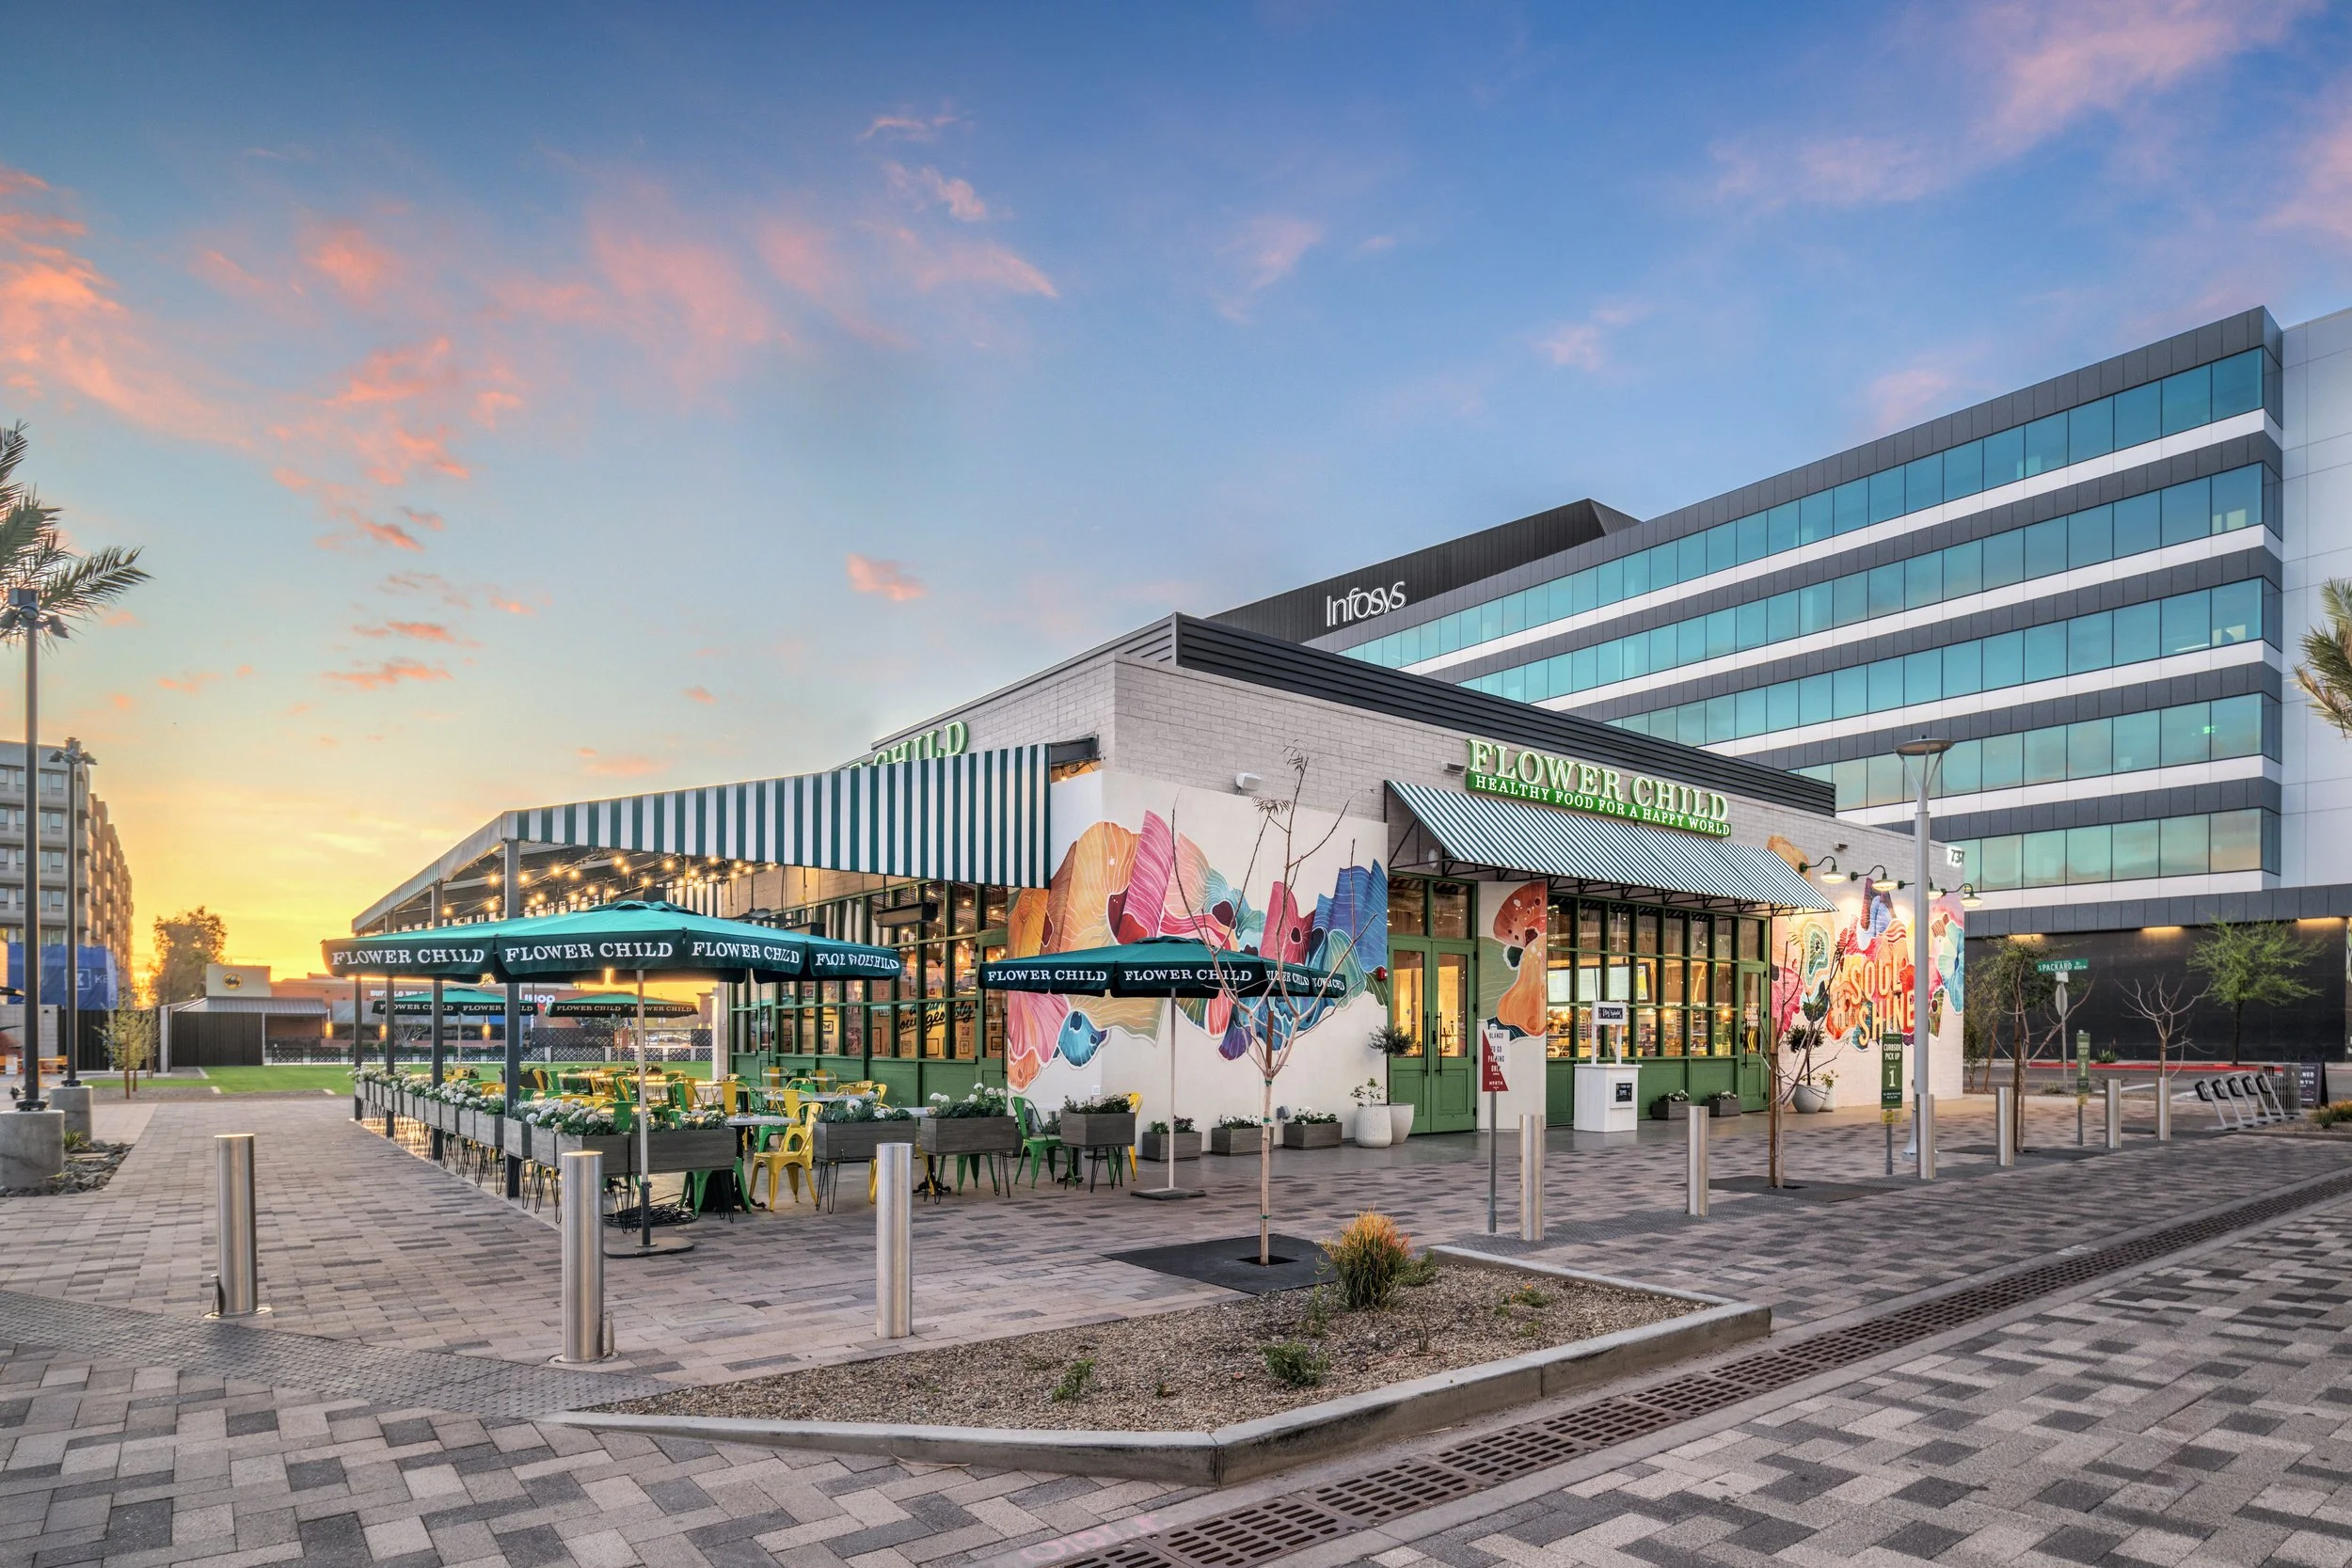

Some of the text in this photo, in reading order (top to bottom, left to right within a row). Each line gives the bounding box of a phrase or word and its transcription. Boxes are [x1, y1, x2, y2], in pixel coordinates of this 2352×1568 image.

[1327, 581, 1406, 626] Infosys
[1467, 738, 1728, 821] FLOWER CHILD
[1475, 775, 1730, 835] HEALTHY FOOD FOR A HAPPY WORLD
[331, 948, 485, 965] FLOWER CHILD
[505, 942, 673, 962] FLOWER CHILD
[691, 942, 800, 964] FLOWER CHILD
[988, 970, 1107, 982] FLOWER CHILD
[1124, 969, 1252, 981] FLOWER CHILD
[2042, 962, 2073, 971] PACKARD
[1851, 955, 1902, 1006] SOUL
[1858, 990, 1915, 1046] SHINE
[1883, 1043, 1901, 1052] CURBSIDE
[1889, 1069, 1896, 1087] 1
